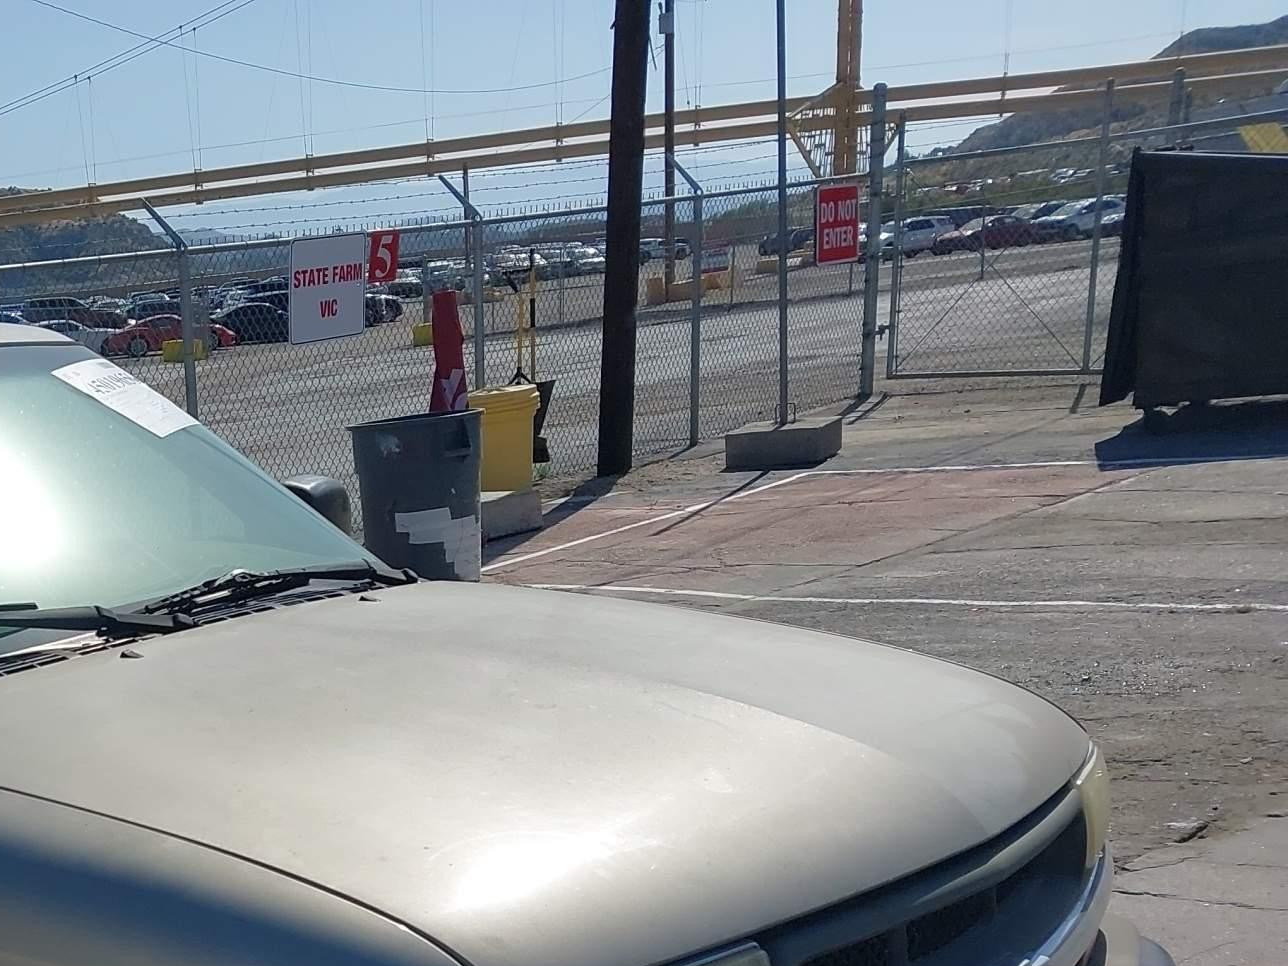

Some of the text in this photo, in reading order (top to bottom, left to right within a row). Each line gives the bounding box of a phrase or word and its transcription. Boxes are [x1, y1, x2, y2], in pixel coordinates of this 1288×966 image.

[820, 199, 857, 223] DO NOT
[823, 226, 854, 250] ENTER
[374, 235, 393, 278] 5
[293, 263, 363, 289] STATE FARM
[319, 298, 338, 319] VIC
